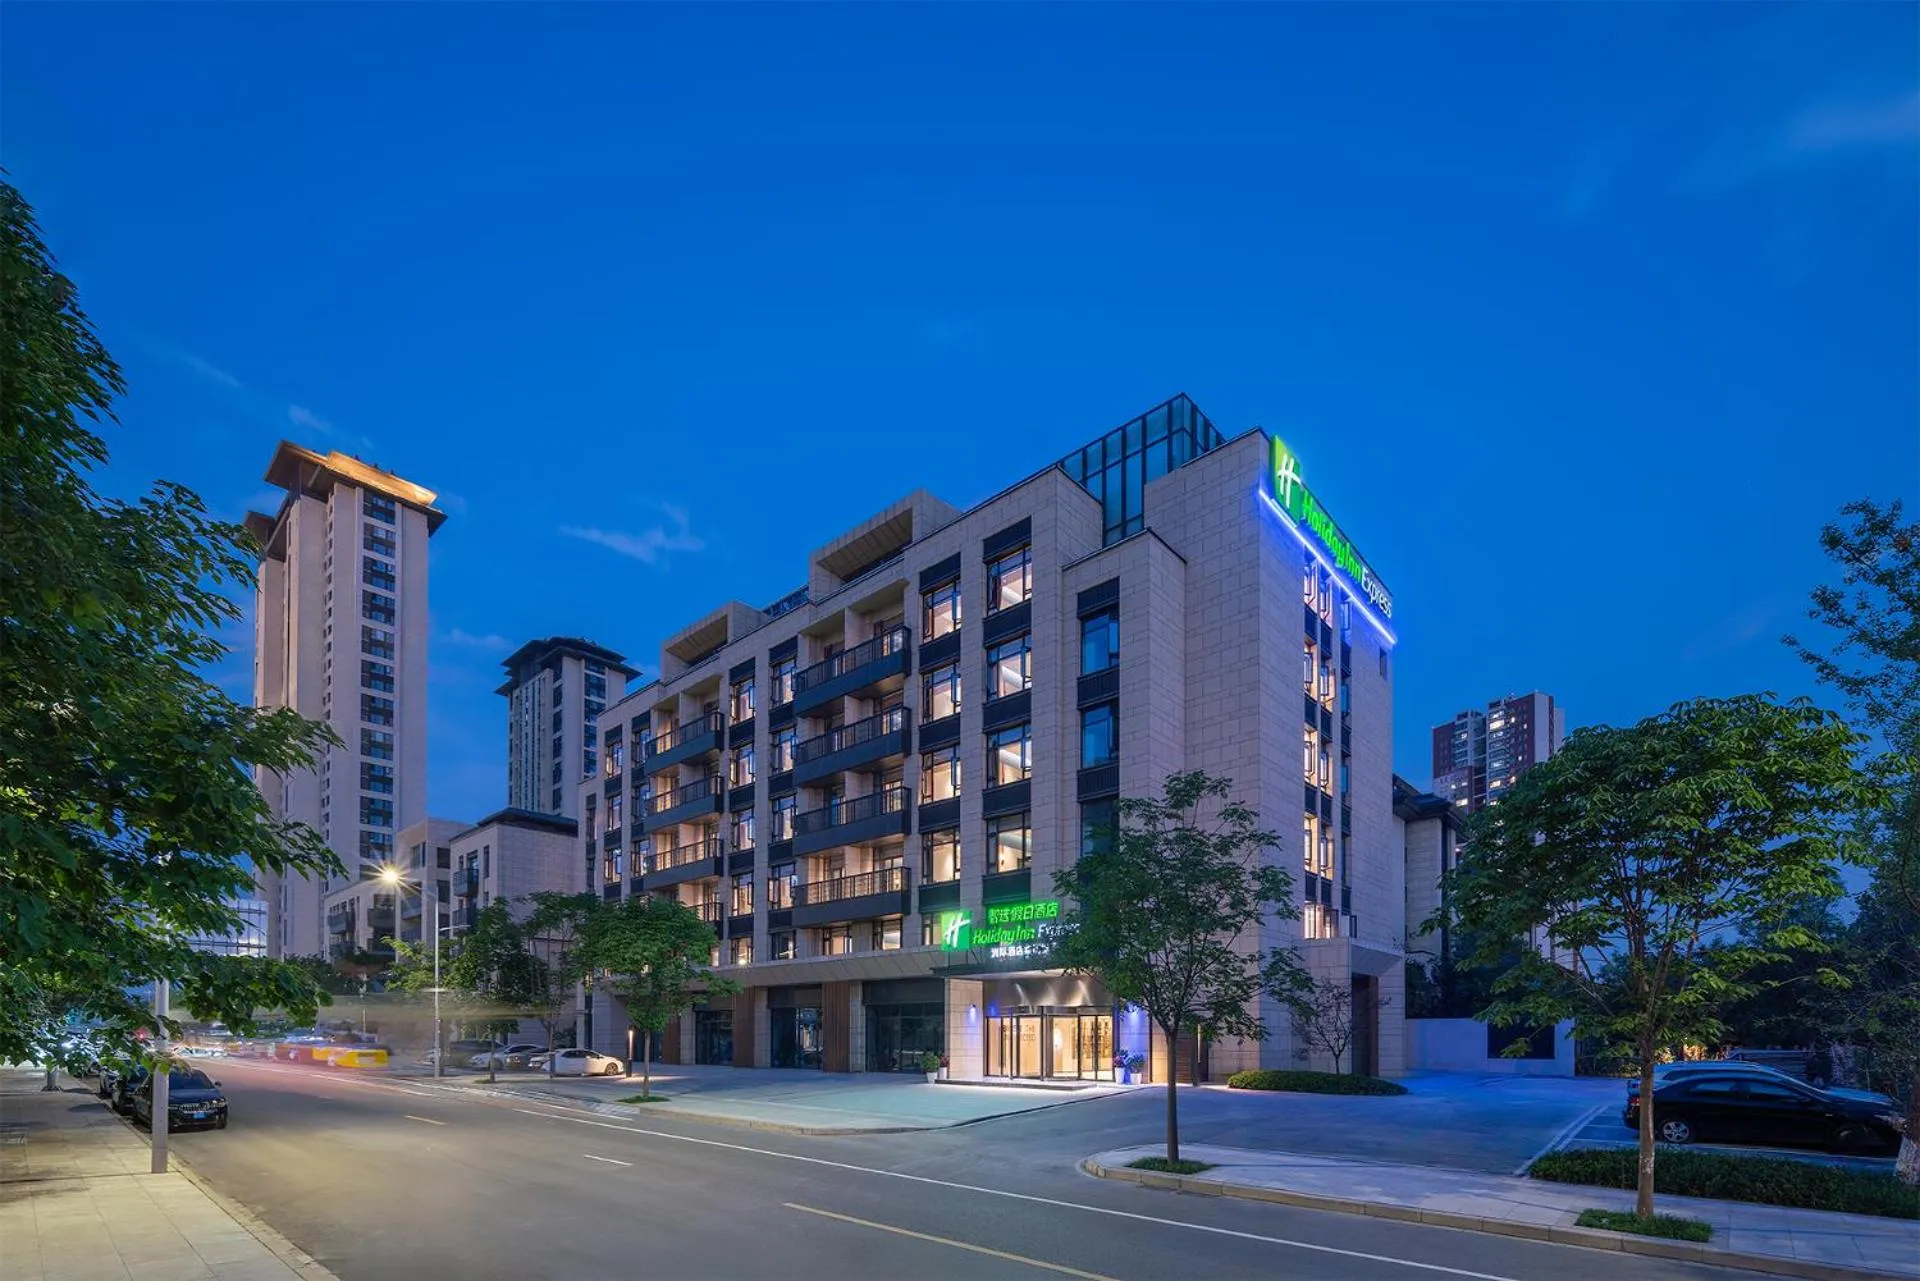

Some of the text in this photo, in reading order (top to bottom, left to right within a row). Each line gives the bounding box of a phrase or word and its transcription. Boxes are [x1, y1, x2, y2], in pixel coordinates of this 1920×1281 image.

[1302, 490, 1392, 619] Holiday Inn Express
[973, 927, 1014, 944] Holiday
[1015, 925, 1035, 941] Inn
